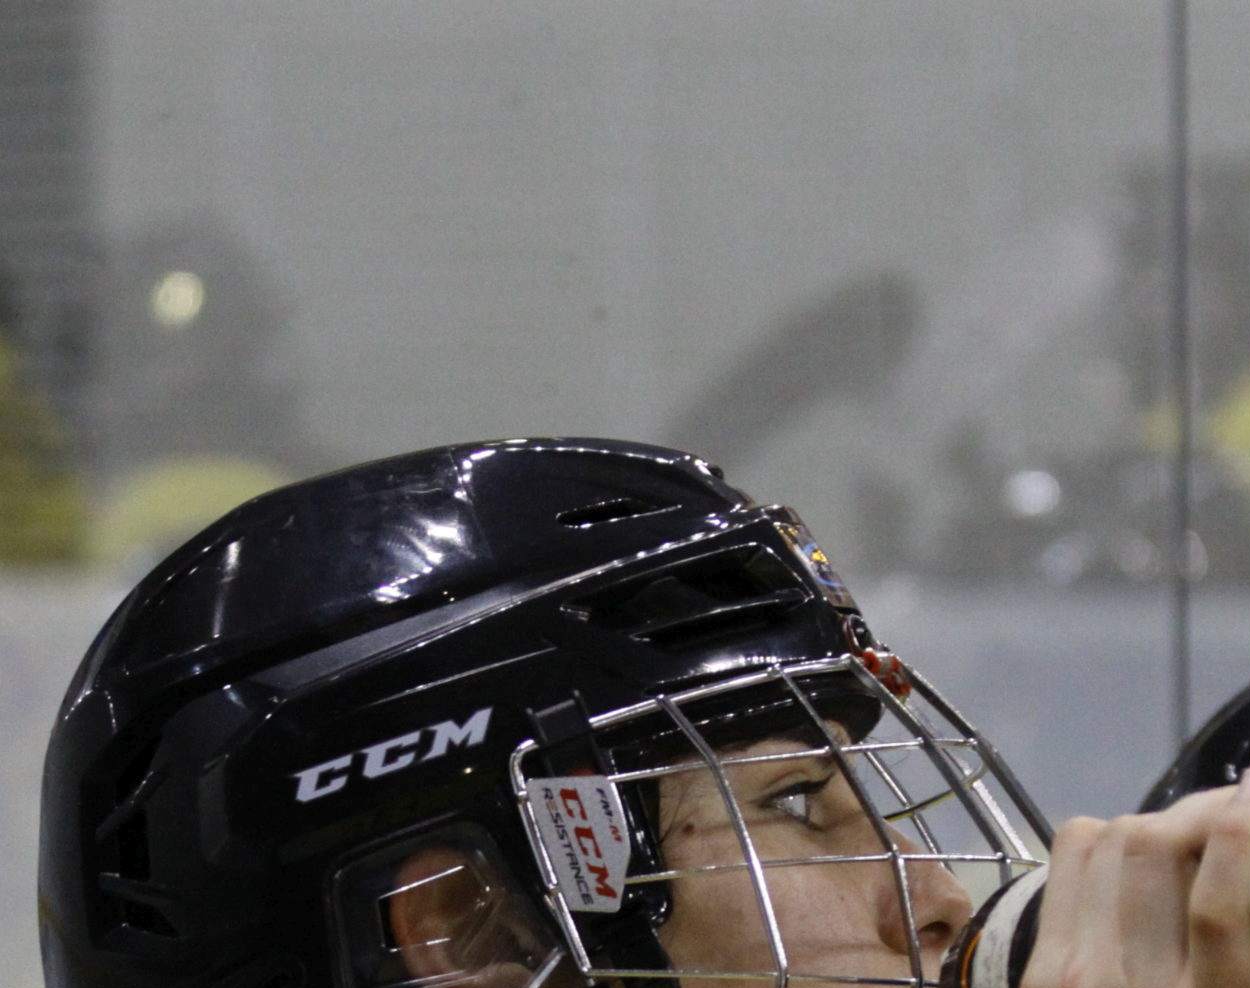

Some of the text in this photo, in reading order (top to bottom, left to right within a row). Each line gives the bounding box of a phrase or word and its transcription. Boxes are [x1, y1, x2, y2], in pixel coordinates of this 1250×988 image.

[294, 708, 493, 803] CCM
[544, 787, 594, 904] RESISTANCE
[560, 788, 618, 899] CCM
[599, 788, 620, 841] FM-M
